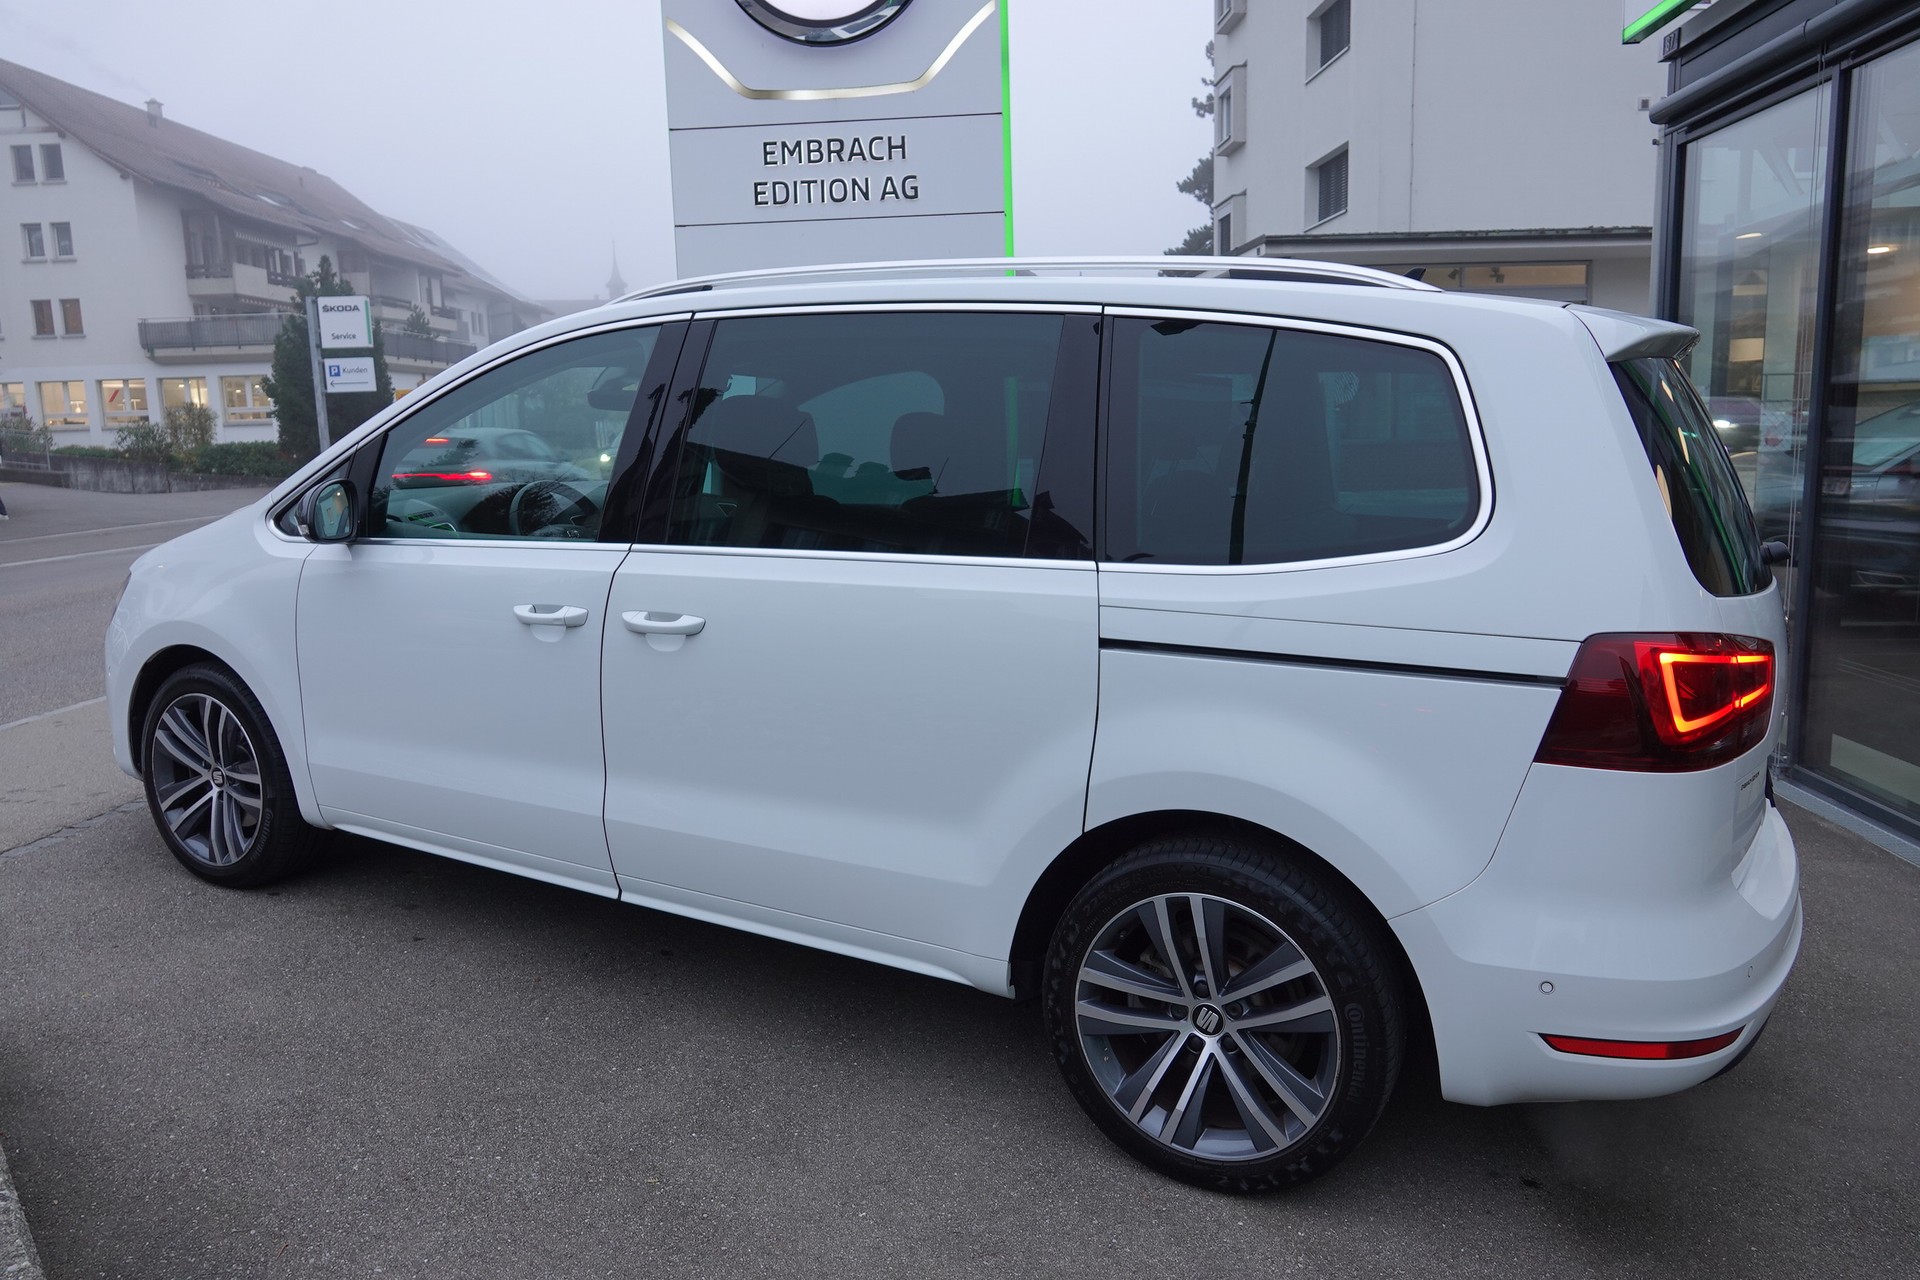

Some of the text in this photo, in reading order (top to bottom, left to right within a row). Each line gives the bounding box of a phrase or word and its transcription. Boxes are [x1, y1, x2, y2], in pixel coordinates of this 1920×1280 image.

[762, 135, 908, 166] EMBRACH
[753, 174, 919, 207] EDITION AG
[322, 304, 360, 313] ŠKODA
[331, 332, 357, 340] Service
[342, 366, 368, 374] Kunden
[1344, 1002, 1370, 1105] Continental
